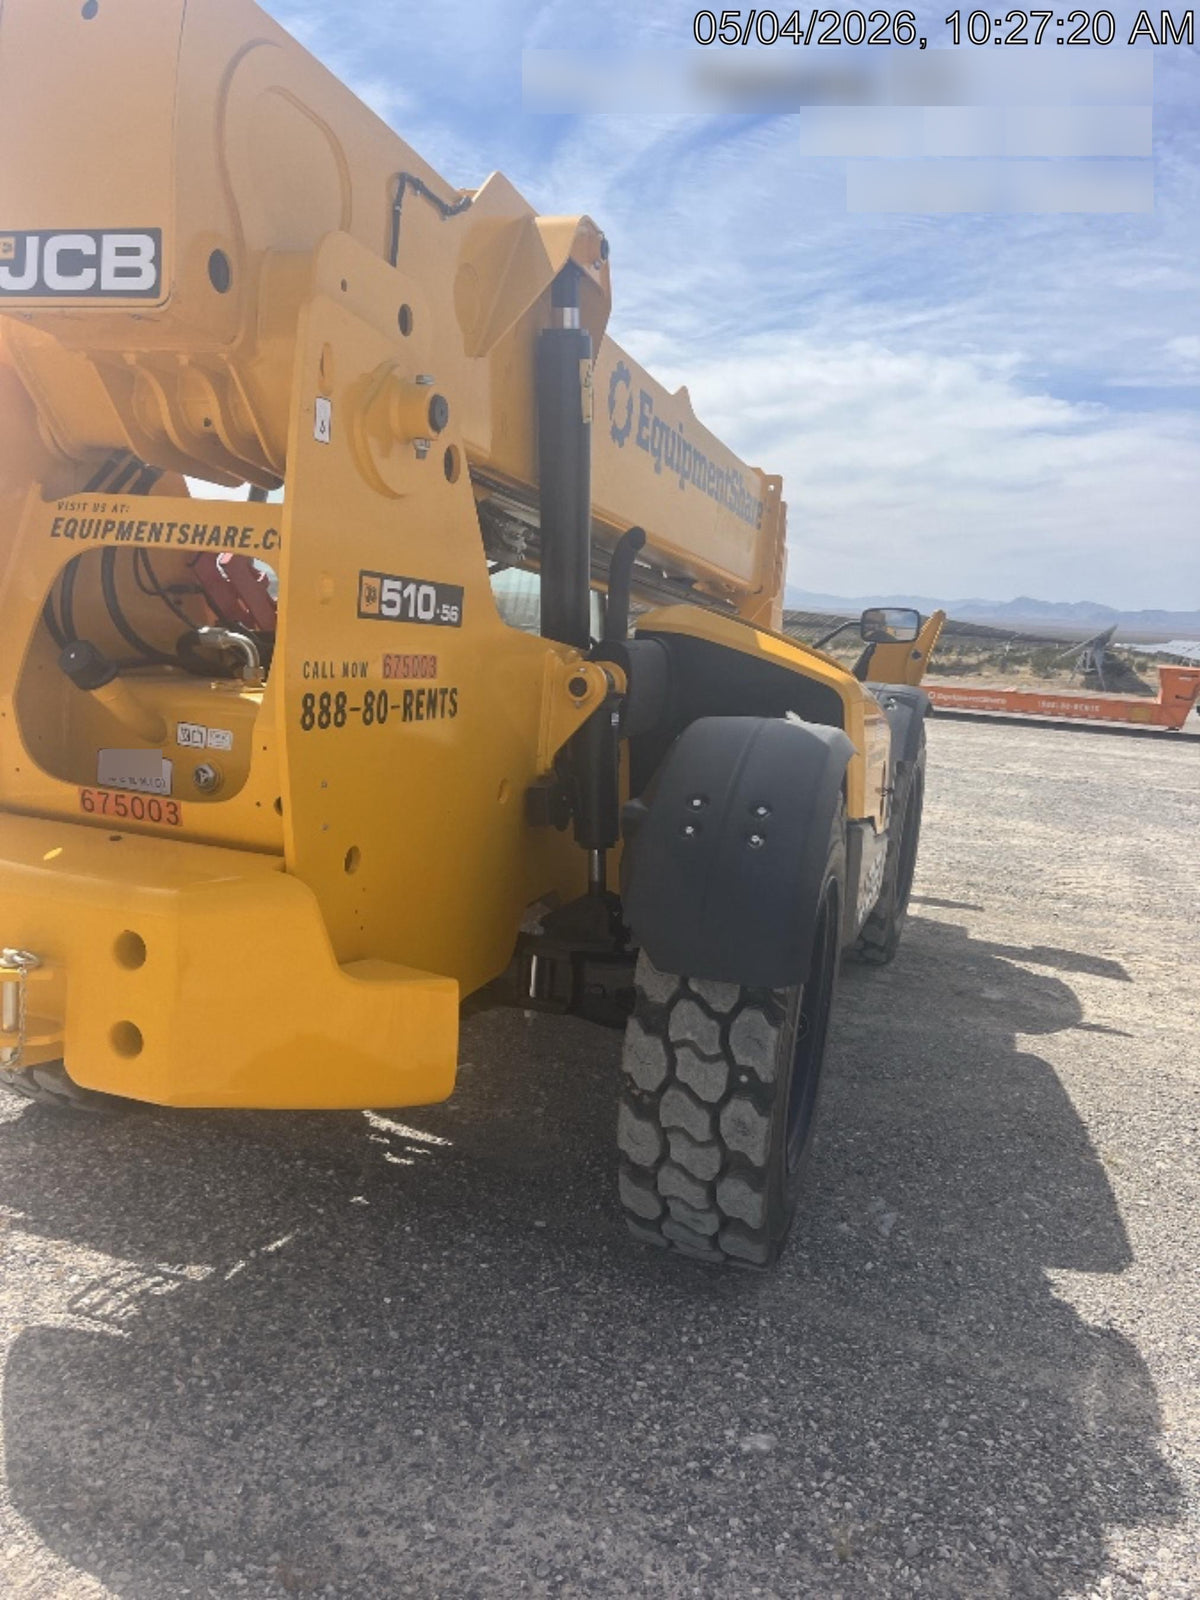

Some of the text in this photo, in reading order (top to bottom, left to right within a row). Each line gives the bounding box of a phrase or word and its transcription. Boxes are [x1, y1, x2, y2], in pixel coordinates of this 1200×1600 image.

[0, 234, 156, 290] JCB
[57, 501, 130, 514] VISIT US AT:
[50, 517, 282, 550] EQUIPMENTSHARE.C
[303, 661, 369, 679] CALL NOW
[383, 654, 437, 679] 675003
[301, 687, 458, 731] 888-80-RENTS
[81, 789, 181, 825] 675003
